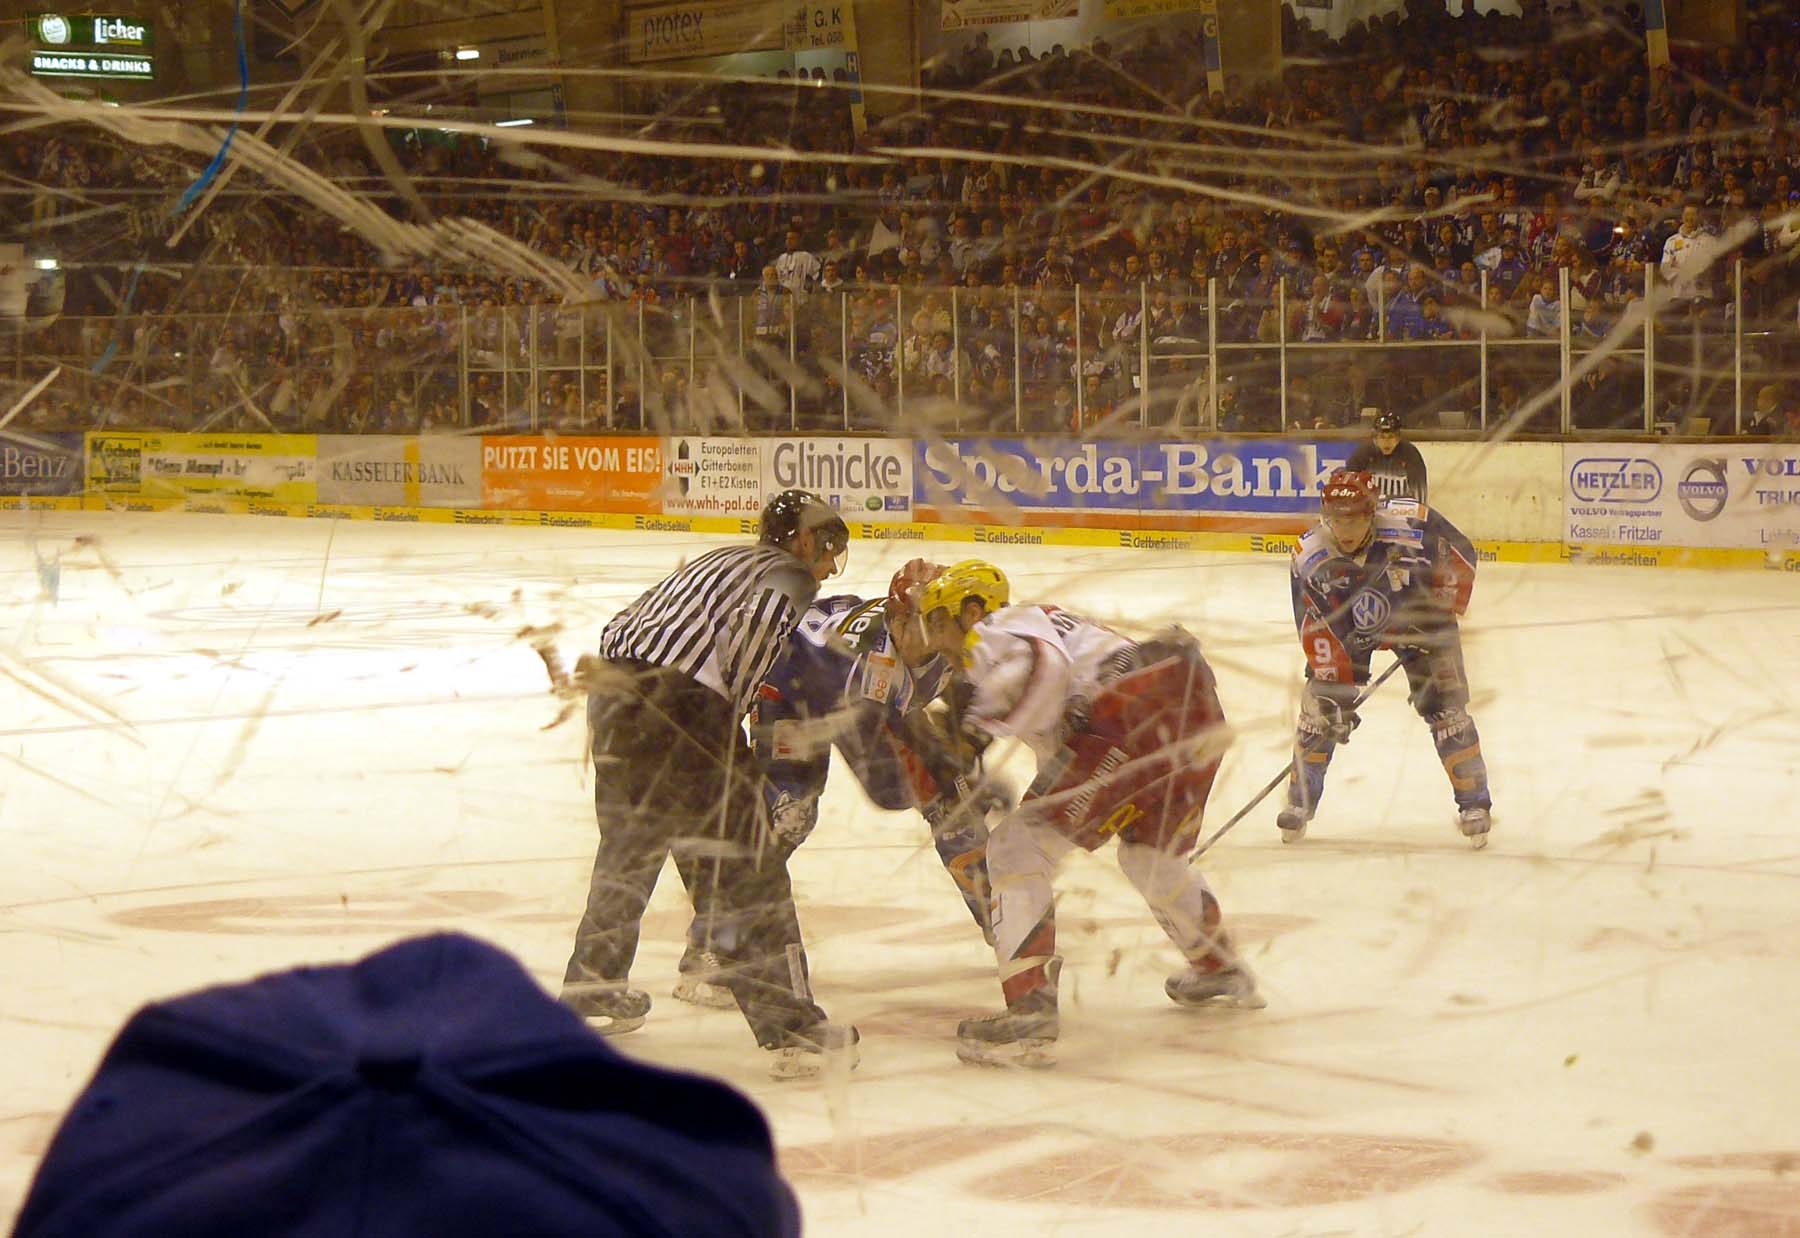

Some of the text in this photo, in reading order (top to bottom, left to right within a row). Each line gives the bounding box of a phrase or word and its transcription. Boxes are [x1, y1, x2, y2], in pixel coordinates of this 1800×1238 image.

[94, 16, 144, 43] Licher
[33, 57, 151, 73] SNACKS & DRINKS
[701, 442, 757, 456] Europaletten
[483, 446, 661, 473] PUTZT SIE VOM EIS!
[701, 459, 753, 472] Gitterboxen
[773, 442, 901, 490] Glinicke
[332, 461, 413, 483] KASSELER
[417, 463, 465, 485] BANK
[1577, 472, 1656, 490] HETZLER
[1681, 486, 1725, 496] VOLVO
[667, 496, 760, 514] www.whh-pal.de
[1571, 507, 1607, 516] VOLVO
[549, 517, 593, 529] GelbeSeiten
[645, 521, 691, 533] GelbeSeiten
[873, 528, 925, 541] GelbeSeiten
[987, 531, 1043, 545] GelbeSeiten
[1619, 525, 1663, 541] Fritzlar
[1132, 535, 1190, 550] GelbeSeiten
[1314, 637, 1332, 664] 9
